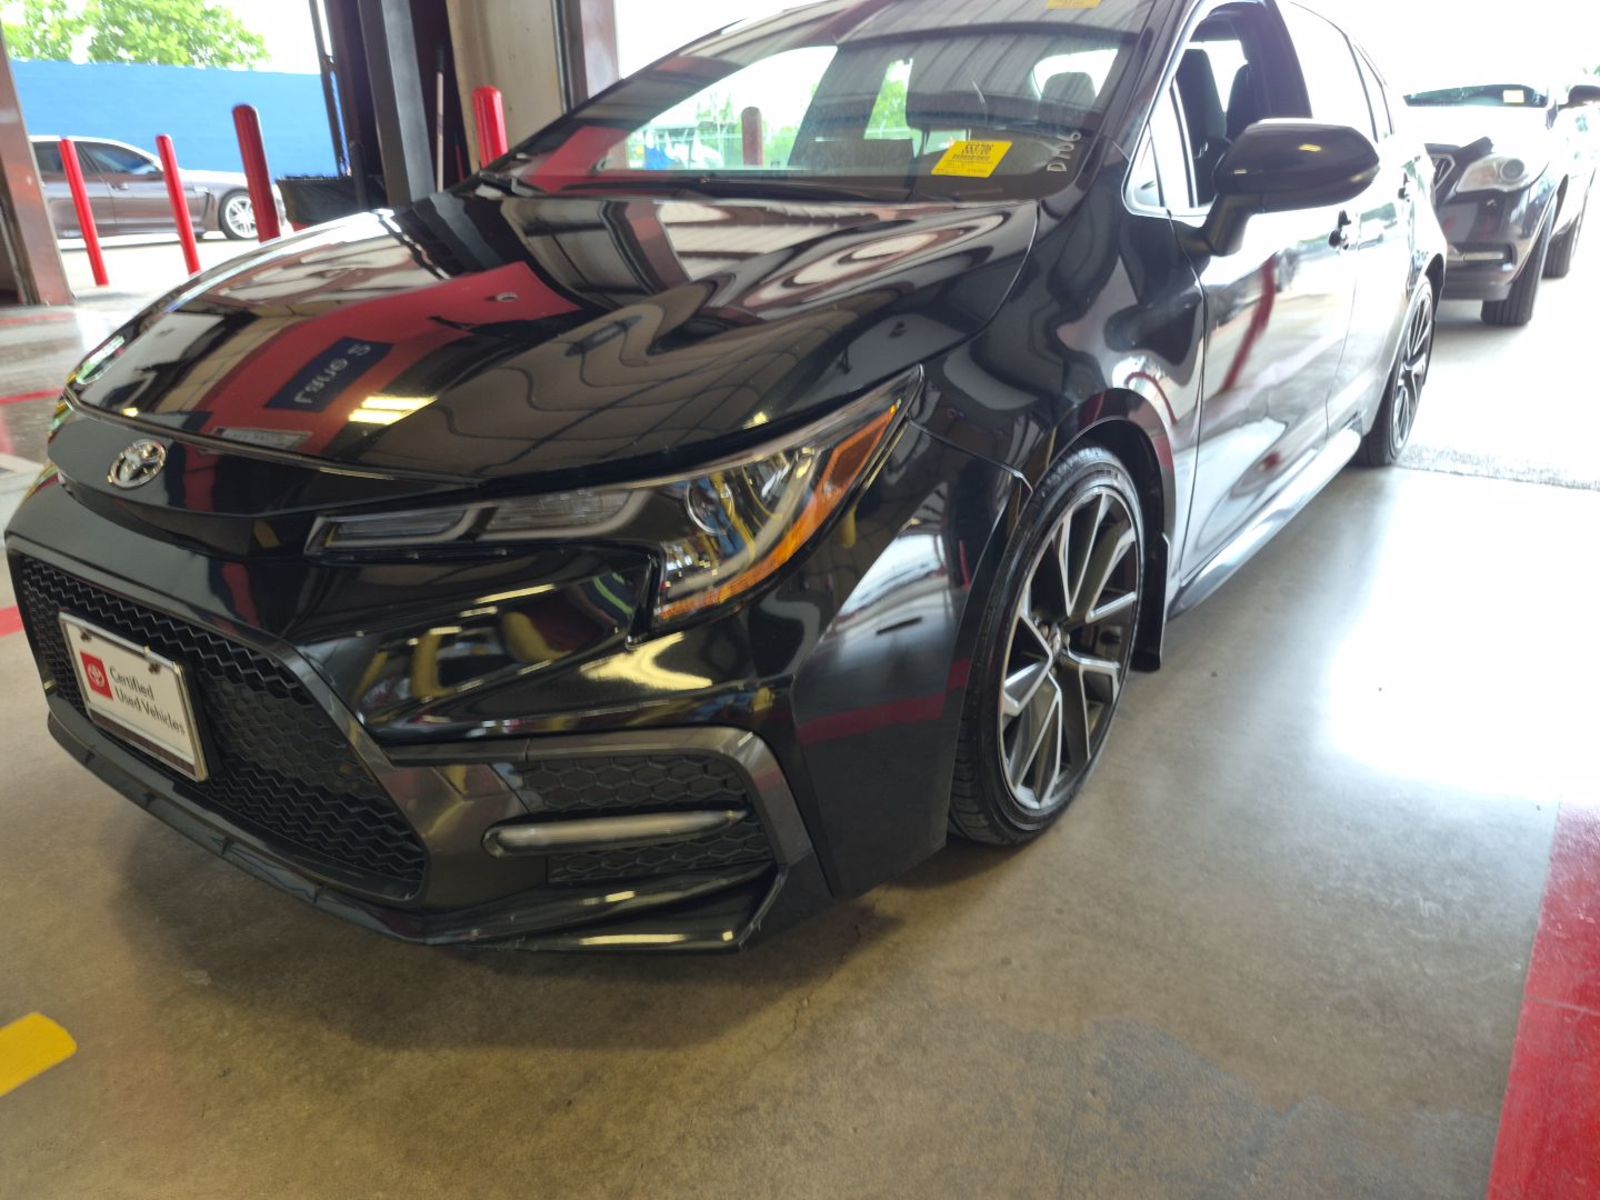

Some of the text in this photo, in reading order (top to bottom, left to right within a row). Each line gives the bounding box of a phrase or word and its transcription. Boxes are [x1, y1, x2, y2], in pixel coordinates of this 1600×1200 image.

[109, 667, 154, 700] Certified
[115, 687, 185, 735] Used Vehicles
